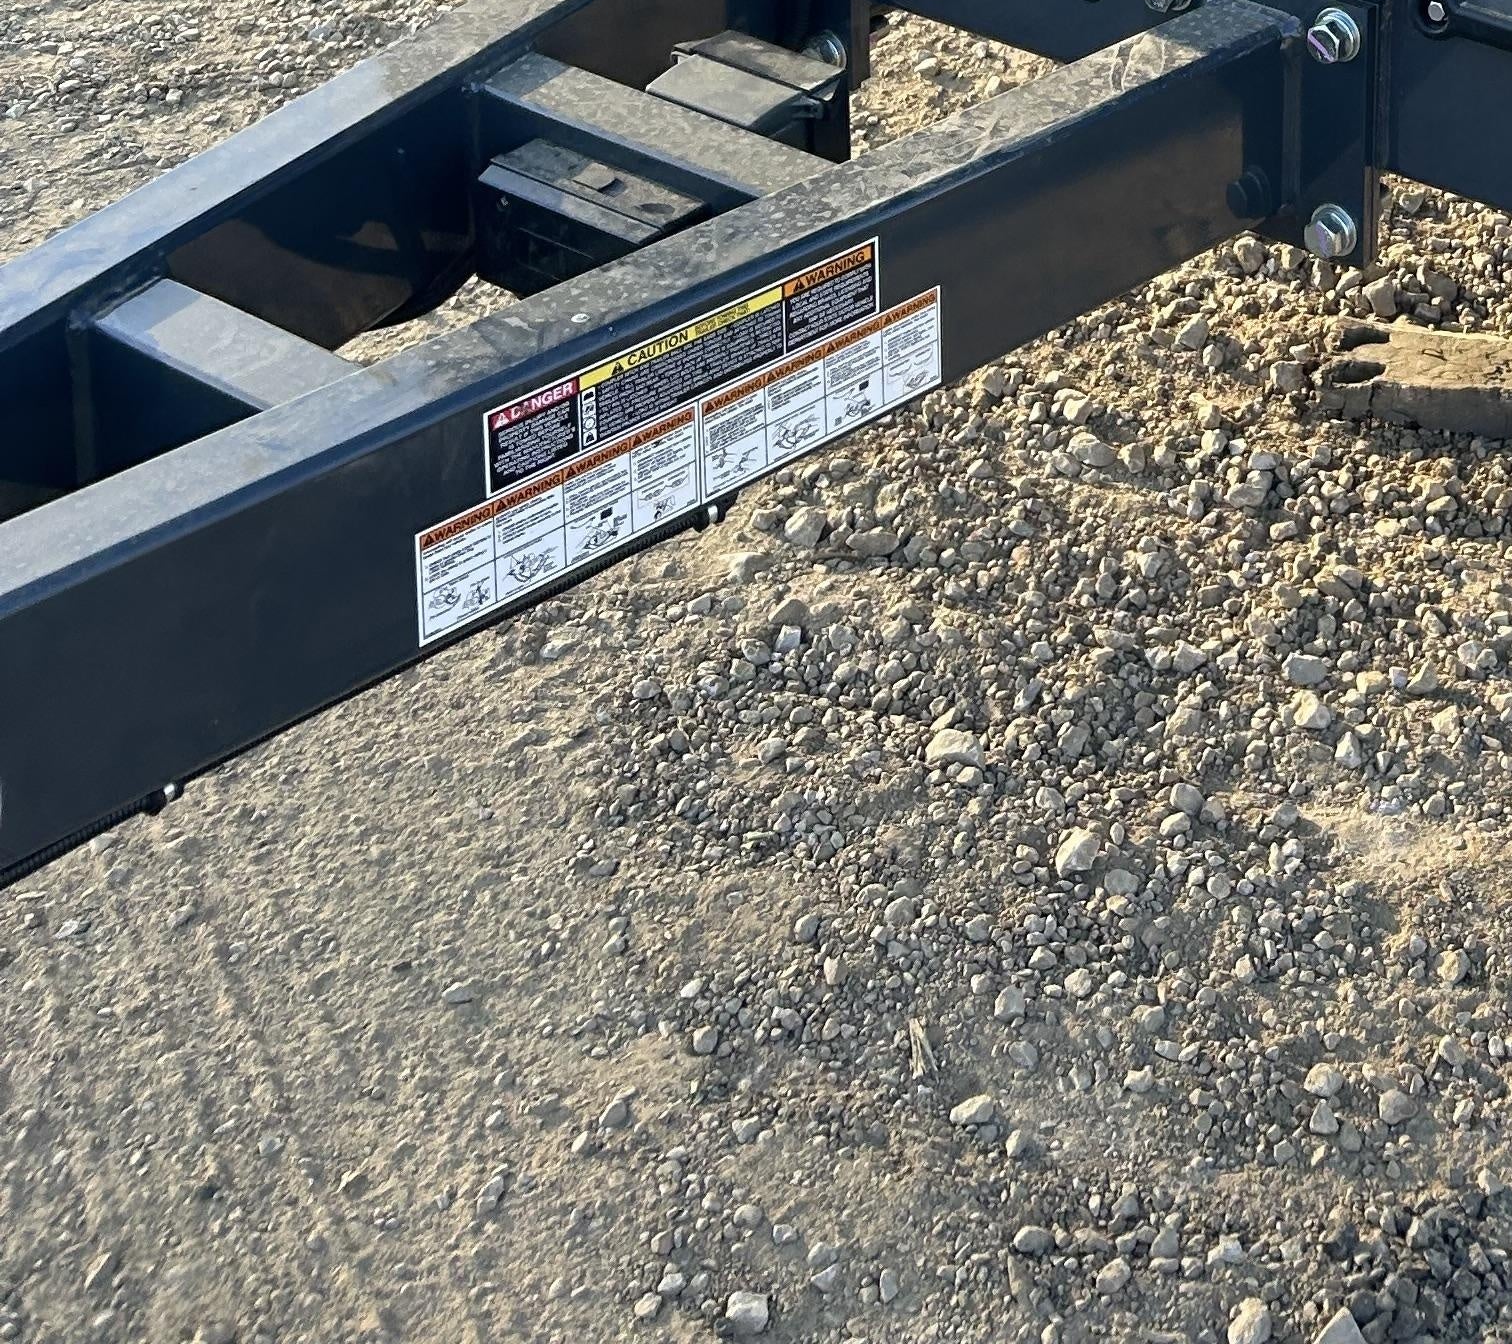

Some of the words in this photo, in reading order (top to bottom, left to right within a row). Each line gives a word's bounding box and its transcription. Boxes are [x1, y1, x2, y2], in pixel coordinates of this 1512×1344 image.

[806, 250, 866, 287] WARNING
[889, 293, 936, 321] WARNING
[628, 330, 689, 367] CAUTION
[832, 321, 880, 349] WARNING
[773, 348, 824, 378] WARNING
[510, 381, 575, 420] DNGER
[712, 379, 763, 409] WARNING
[639, 410, 693, 443] WARNING
[574, 441, 629, 475] WARNING
[504, 475, 562, 509] WARNING
[435, 507, 491, 543] WARNING
